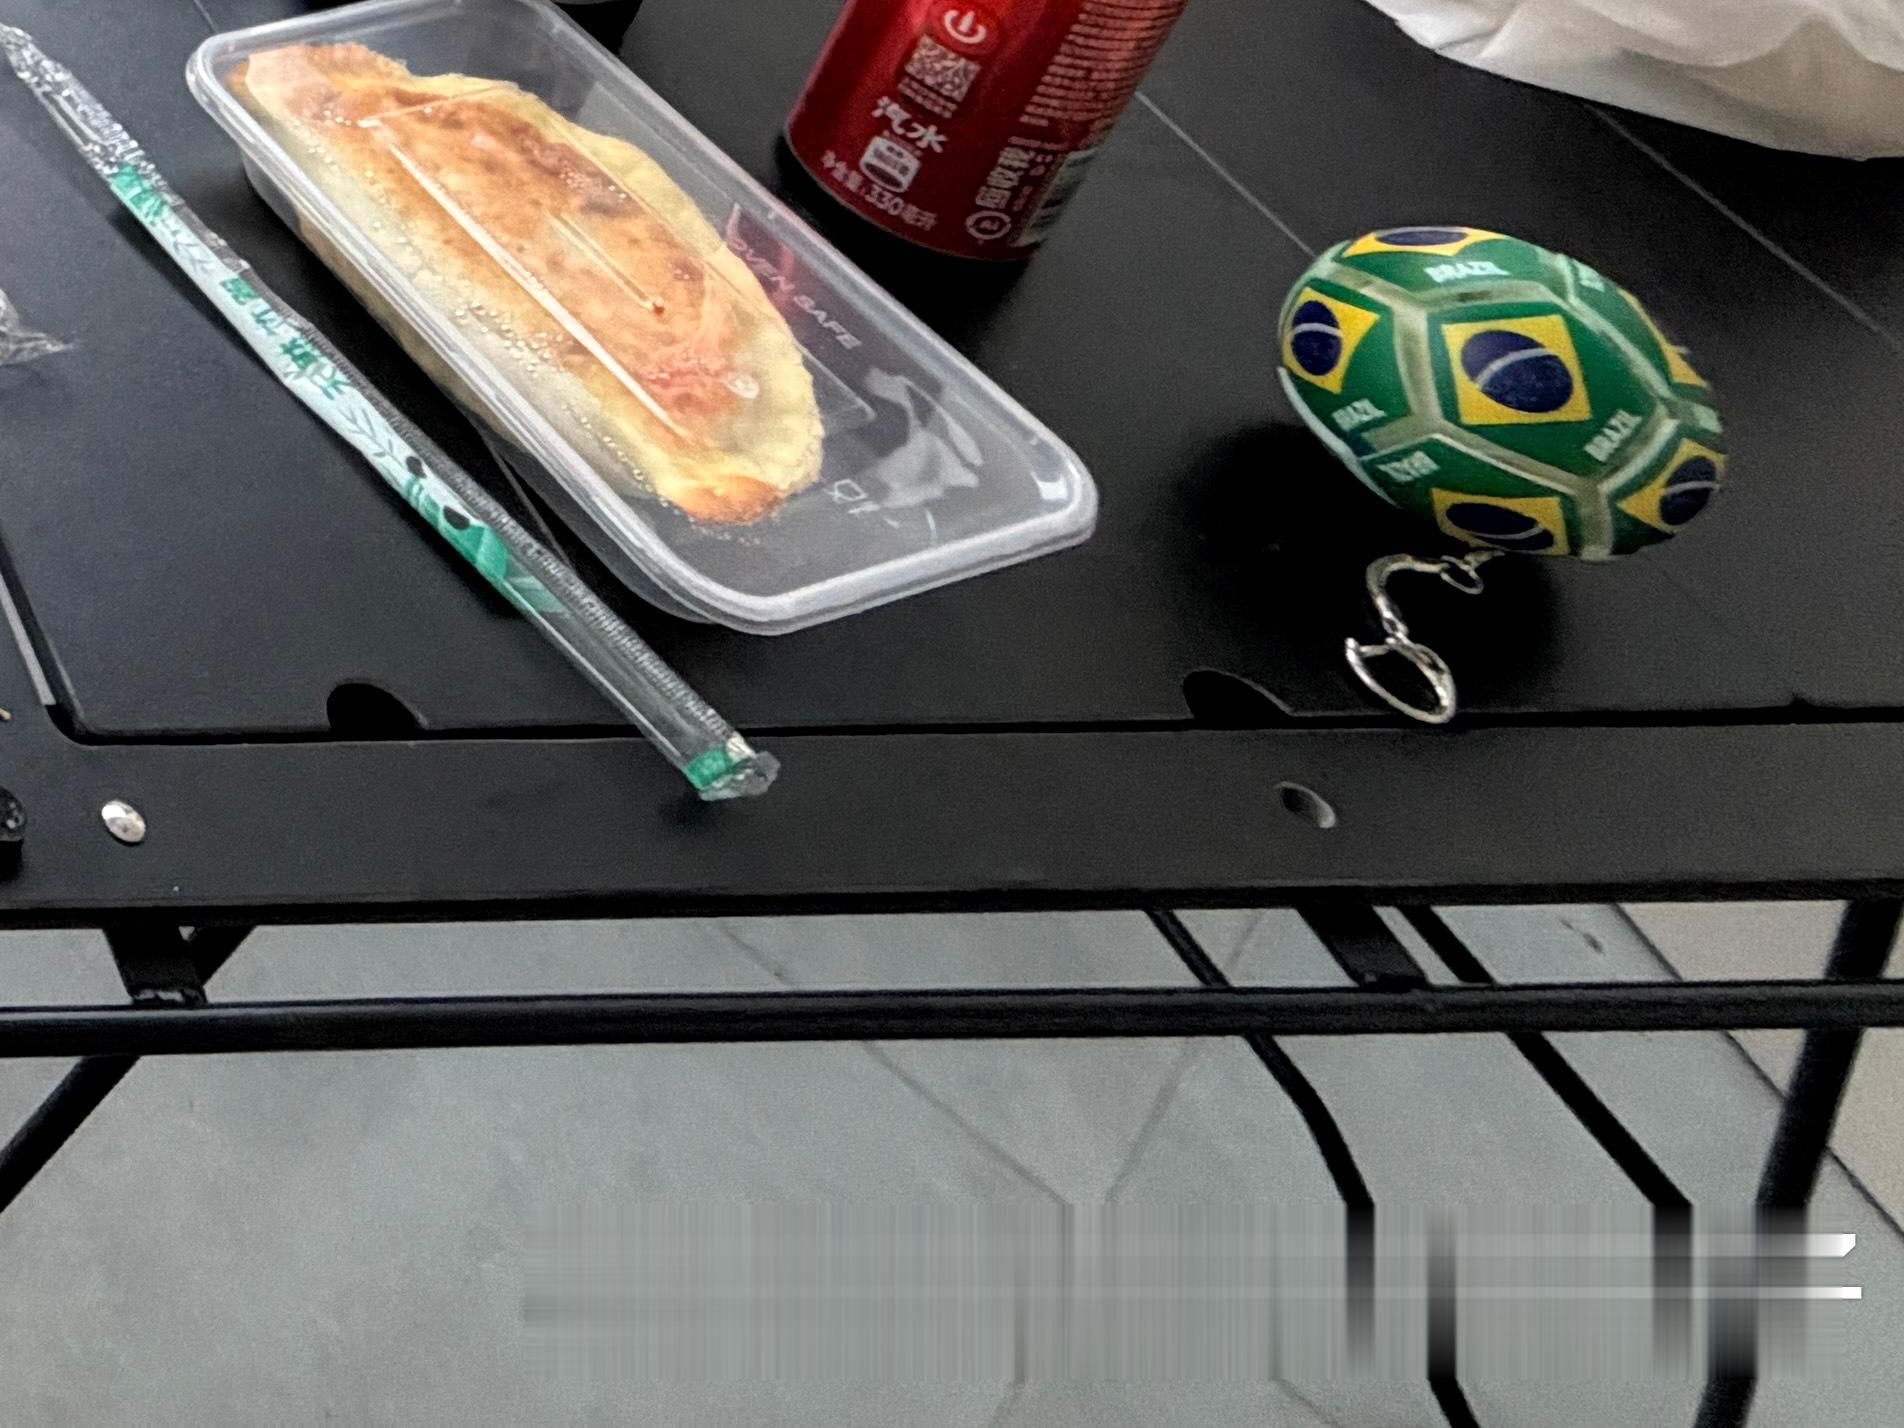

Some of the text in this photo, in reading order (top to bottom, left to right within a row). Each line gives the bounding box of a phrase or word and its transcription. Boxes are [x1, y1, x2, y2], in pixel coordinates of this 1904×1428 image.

[871, 95, 949, 154] 汽水
[1423, 260, 1512, 283] BRAZIL
[792, 294, 863, 350] SAFE
[1583, 409, 1642, 463] BRAZIL
